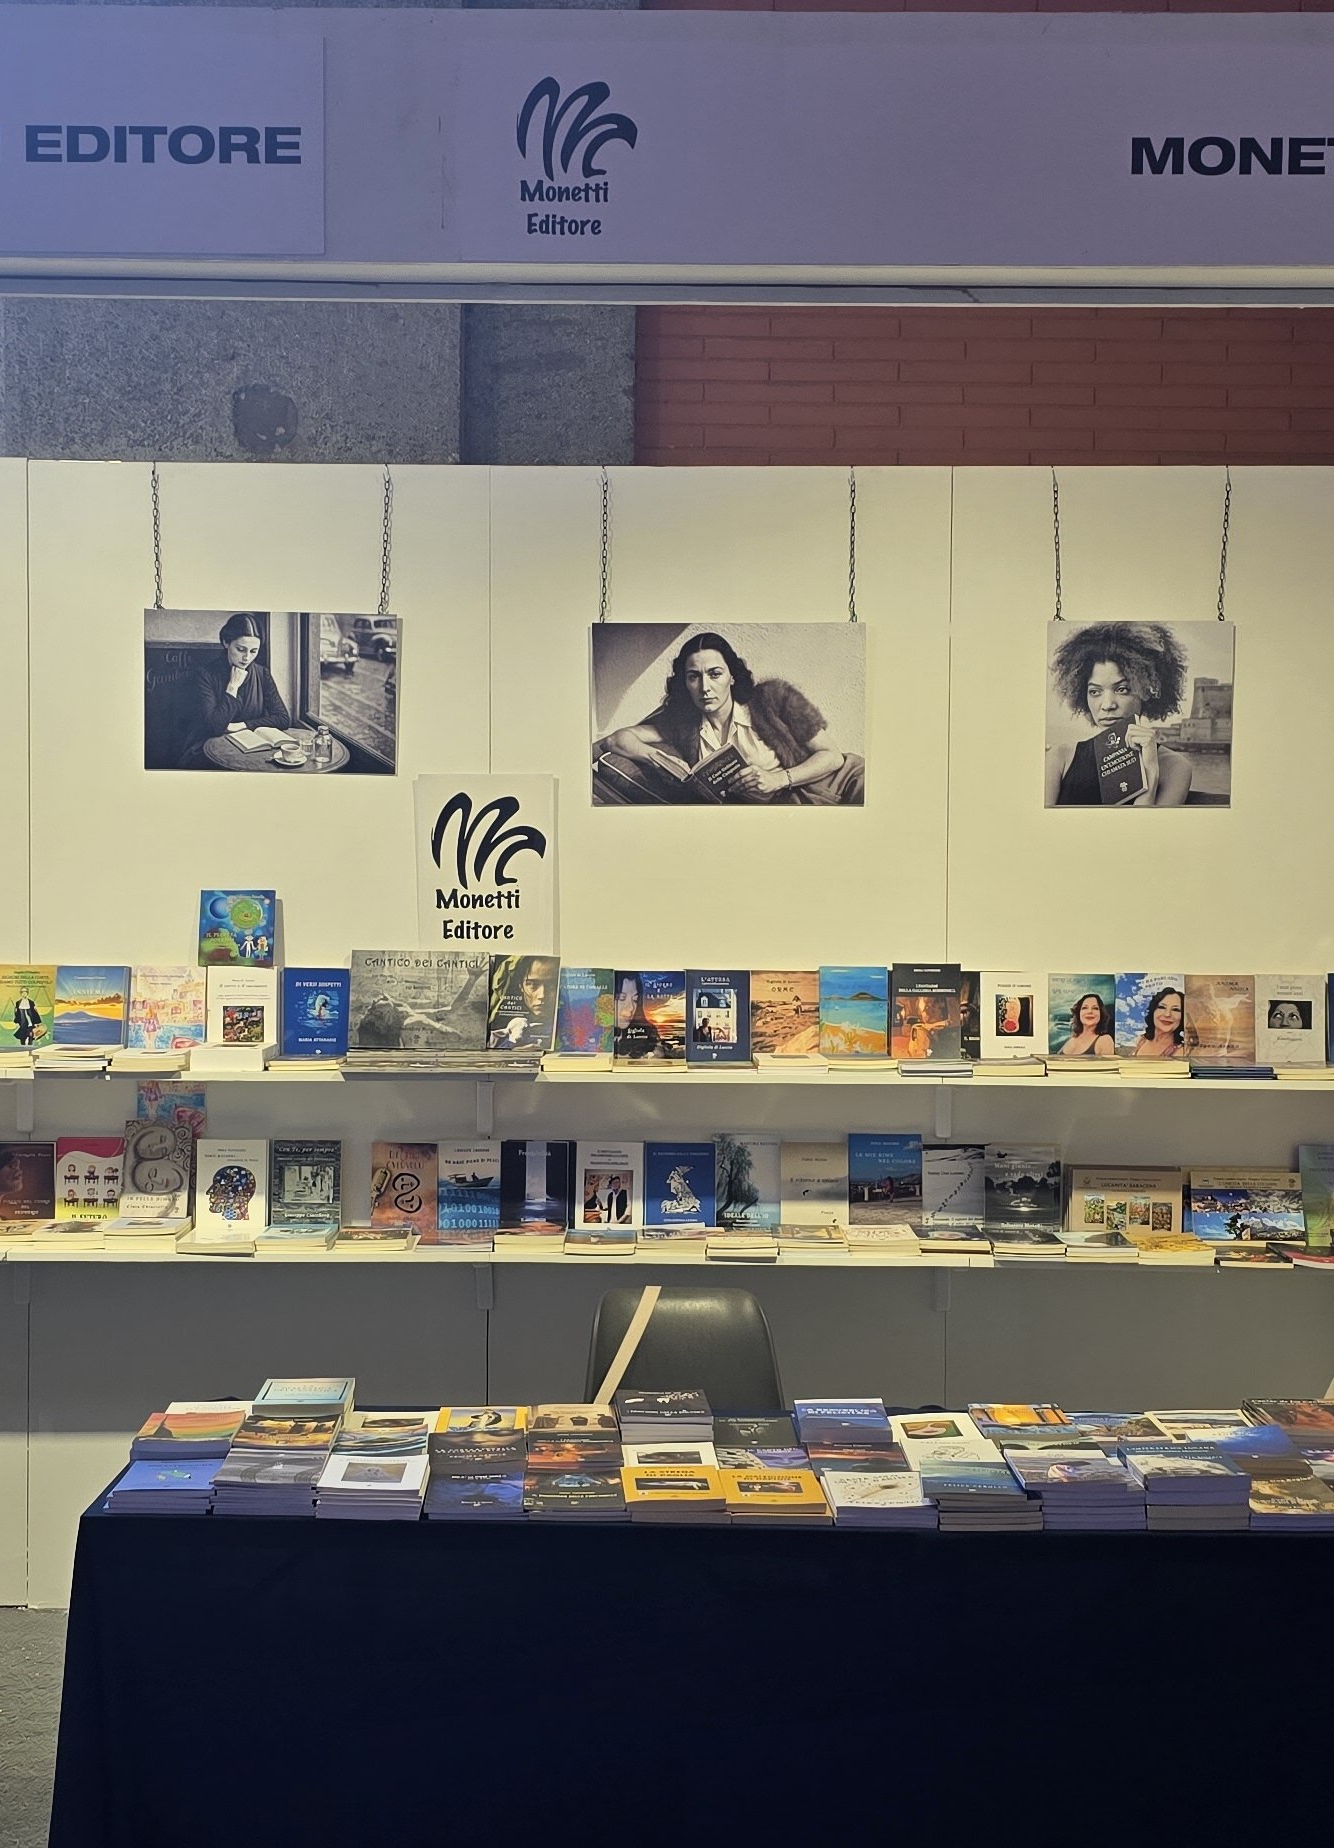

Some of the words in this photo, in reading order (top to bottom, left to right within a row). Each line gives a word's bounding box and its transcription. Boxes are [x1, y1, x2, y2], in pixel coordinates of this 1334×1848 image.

[24, 125, 302, 164] EDITORE
[519, 178, 610, 204] Monetti
[526, 212, 602, 236] Editore
[435, 888, 520, 909] Monetti
[442, 918, 514, 939] Editore
[365, 958, 411, 968] CANTICO
